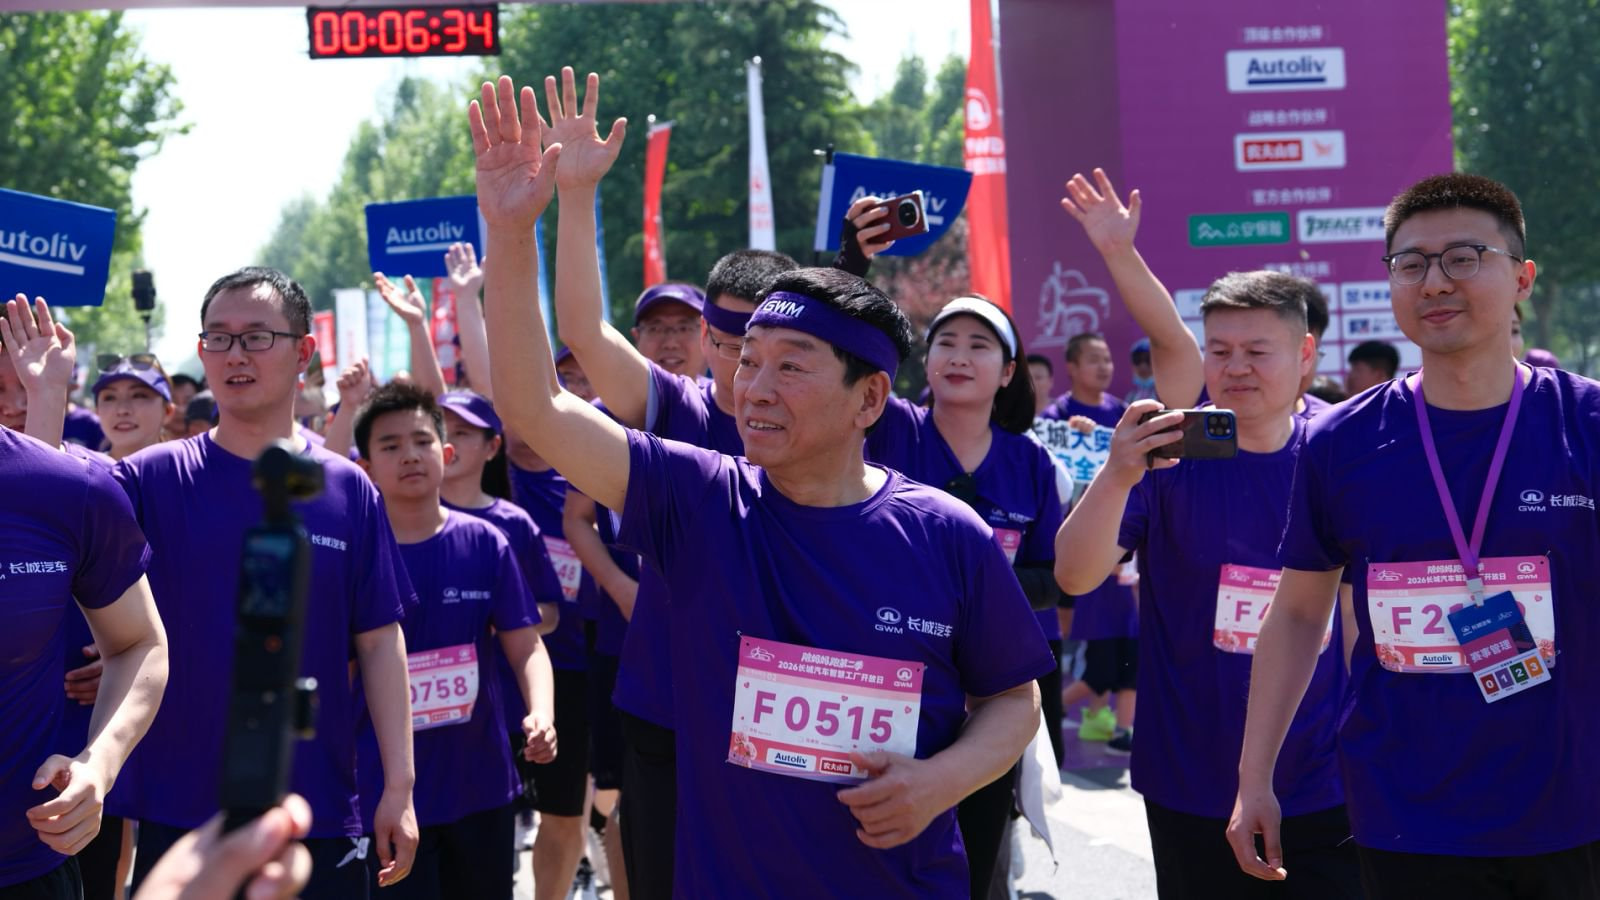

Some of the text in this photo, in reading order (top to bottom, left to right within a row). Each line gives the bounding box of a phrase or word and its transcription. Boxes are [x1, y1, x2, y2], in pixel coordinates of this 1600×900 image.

[314, 10, 493, 55] 00:06:34
[1248, 57, 1326, 75] Autoliv
[386, 221, 464, 244] Autoliv
[763, 300, 805, 318] GWM
[9, 561, 68, 574] 长城汽车
[875, 623, 903, 635] GWM
[907, 616, 953, 638] 长城汽车
[1422, 654, 1453, 663] Autoliv
[1486, 662, 1538, 688] 0 1 2 3
[775, 752, 808, 765] Autoliv
